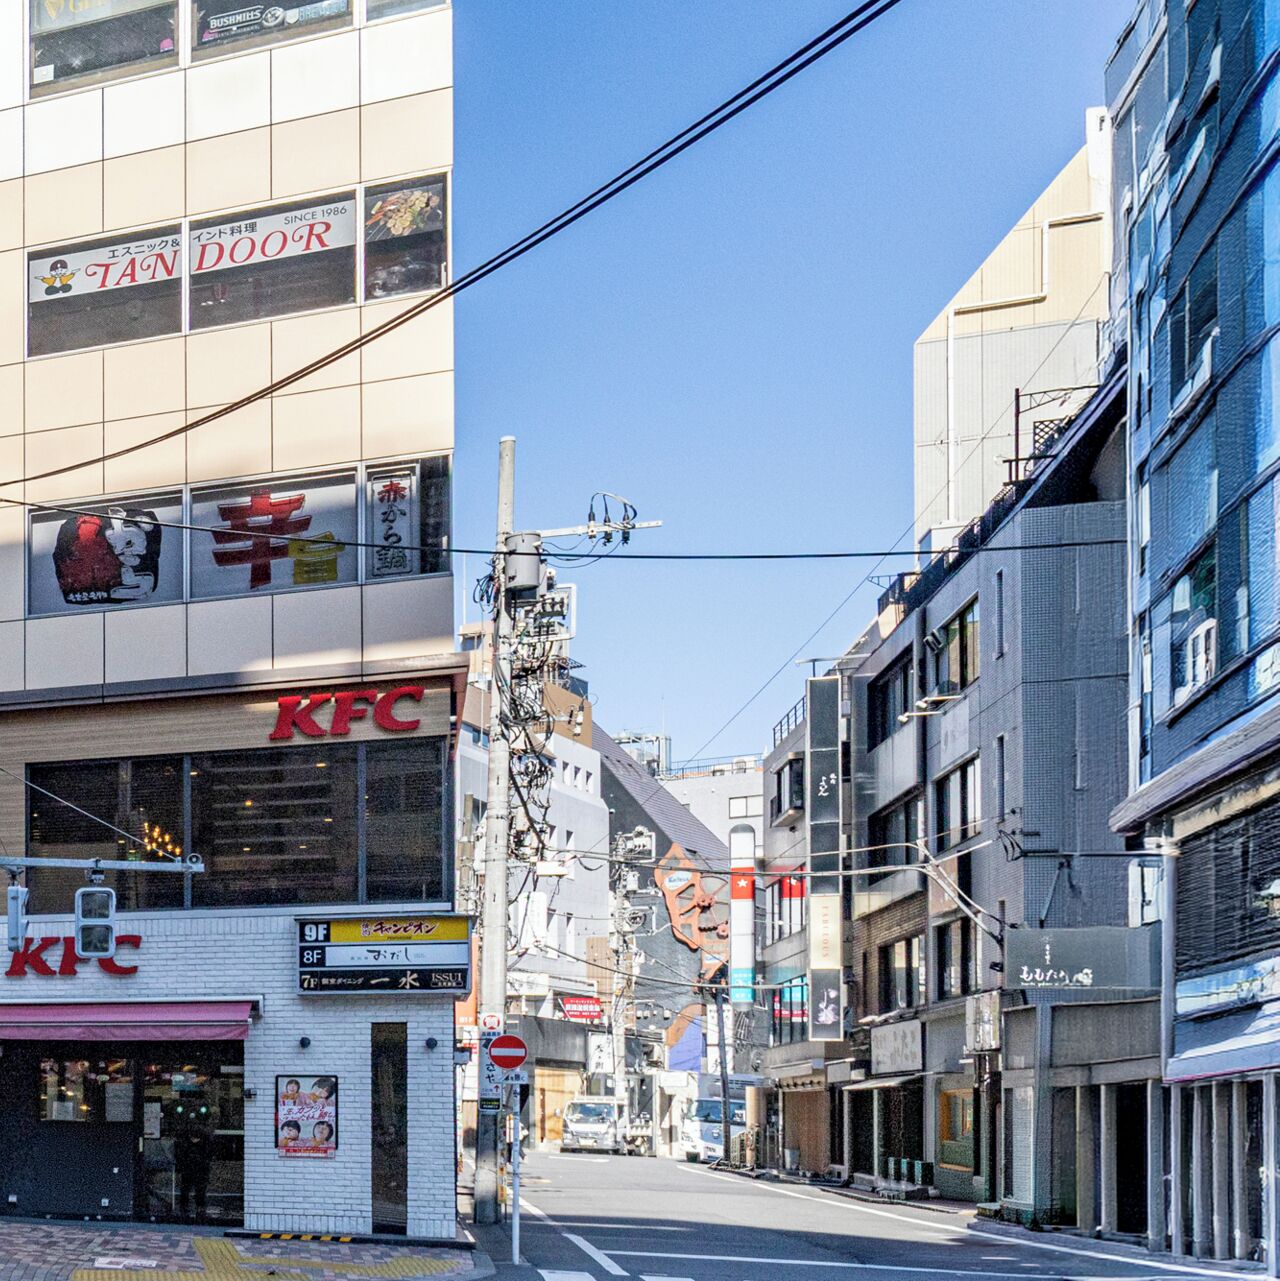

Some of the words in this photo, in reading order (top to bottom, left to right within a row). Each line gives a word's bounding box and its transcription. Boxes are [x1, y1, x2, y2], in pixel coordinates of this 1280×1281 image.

[283, 211, 318, 225] SINCE
[321, 205, 348, 219] 1986
[192, 220, 258, 243] インド料理
[268, 685, 426, 741] KFC
[304, 923, 328, 941] 9F
[373, 921, 439, 935] チャンピオン
[4, 934, 143, 977] KFC
[303, 950, 322, 963] 8F
[301, 975, 318, 988] 7F
[431, 972, 463, 982] ISSUI
